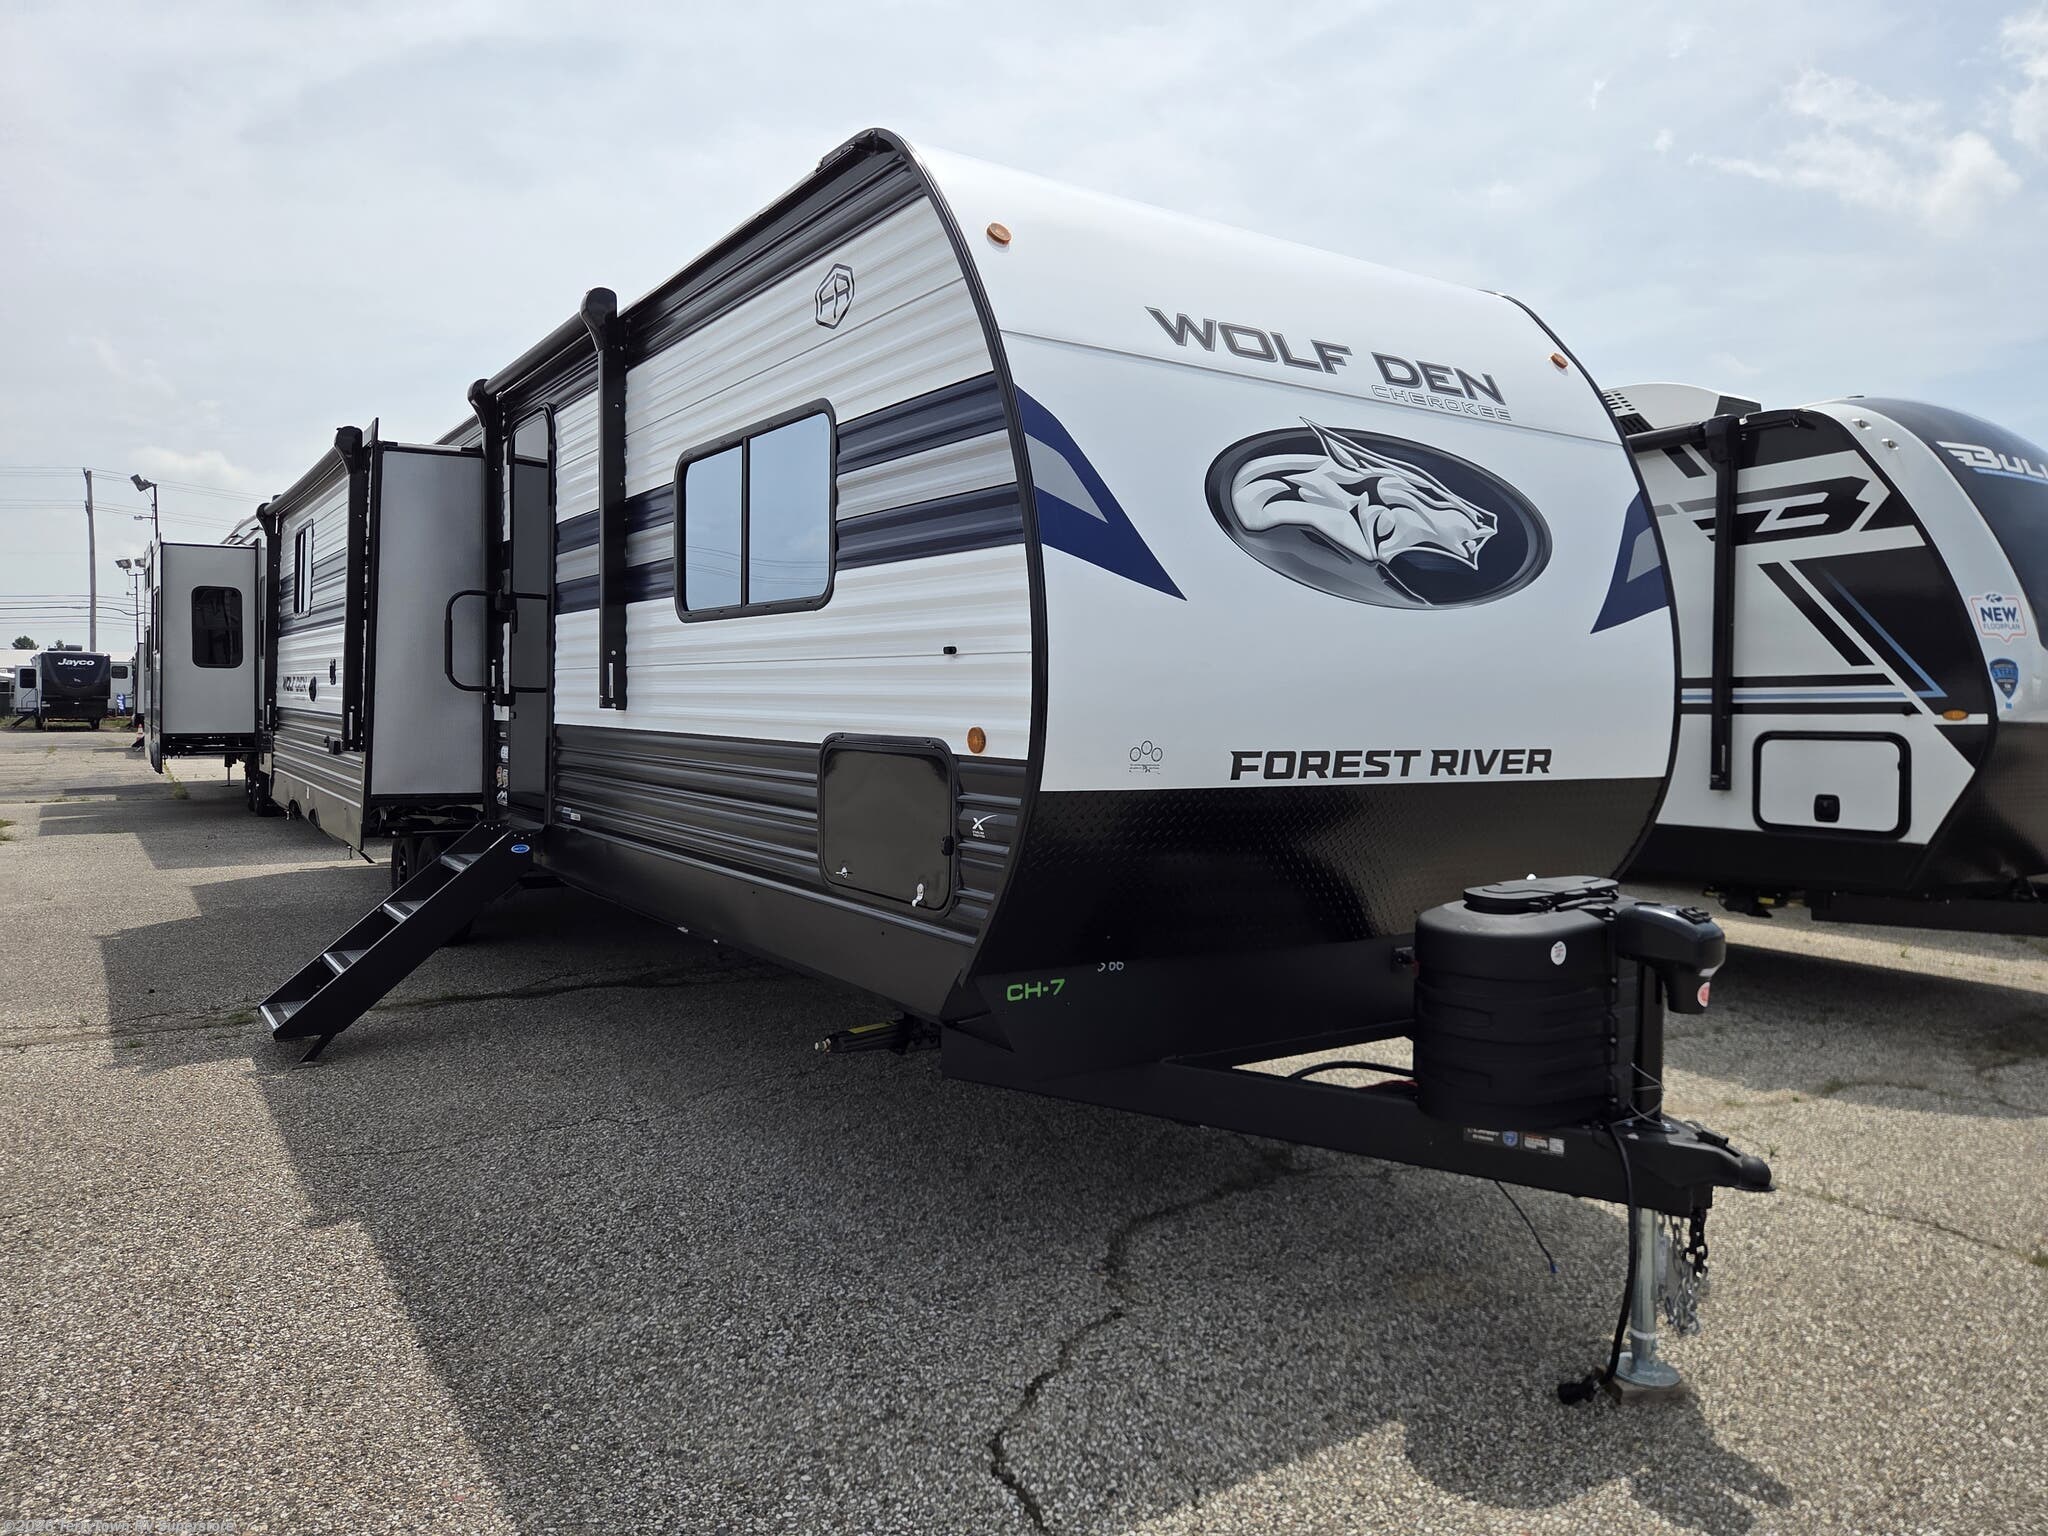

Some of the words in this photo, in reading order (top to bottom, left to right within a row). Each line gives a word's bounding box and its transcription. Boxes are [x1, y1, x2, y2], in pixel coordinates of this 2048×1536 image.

[1145, 305, 1352, 375] WOLF
[1370, 351, 1506, 406] DEN
[1371, 384, 1512, 421] CHEROKEE
[57, 658, 95, 667] Jayco
[1230, 749, 1421, 781] FOREST
[1430, 748, 1552, 777] RIVER
[1006, 978, 1066, 1002] CH-7
